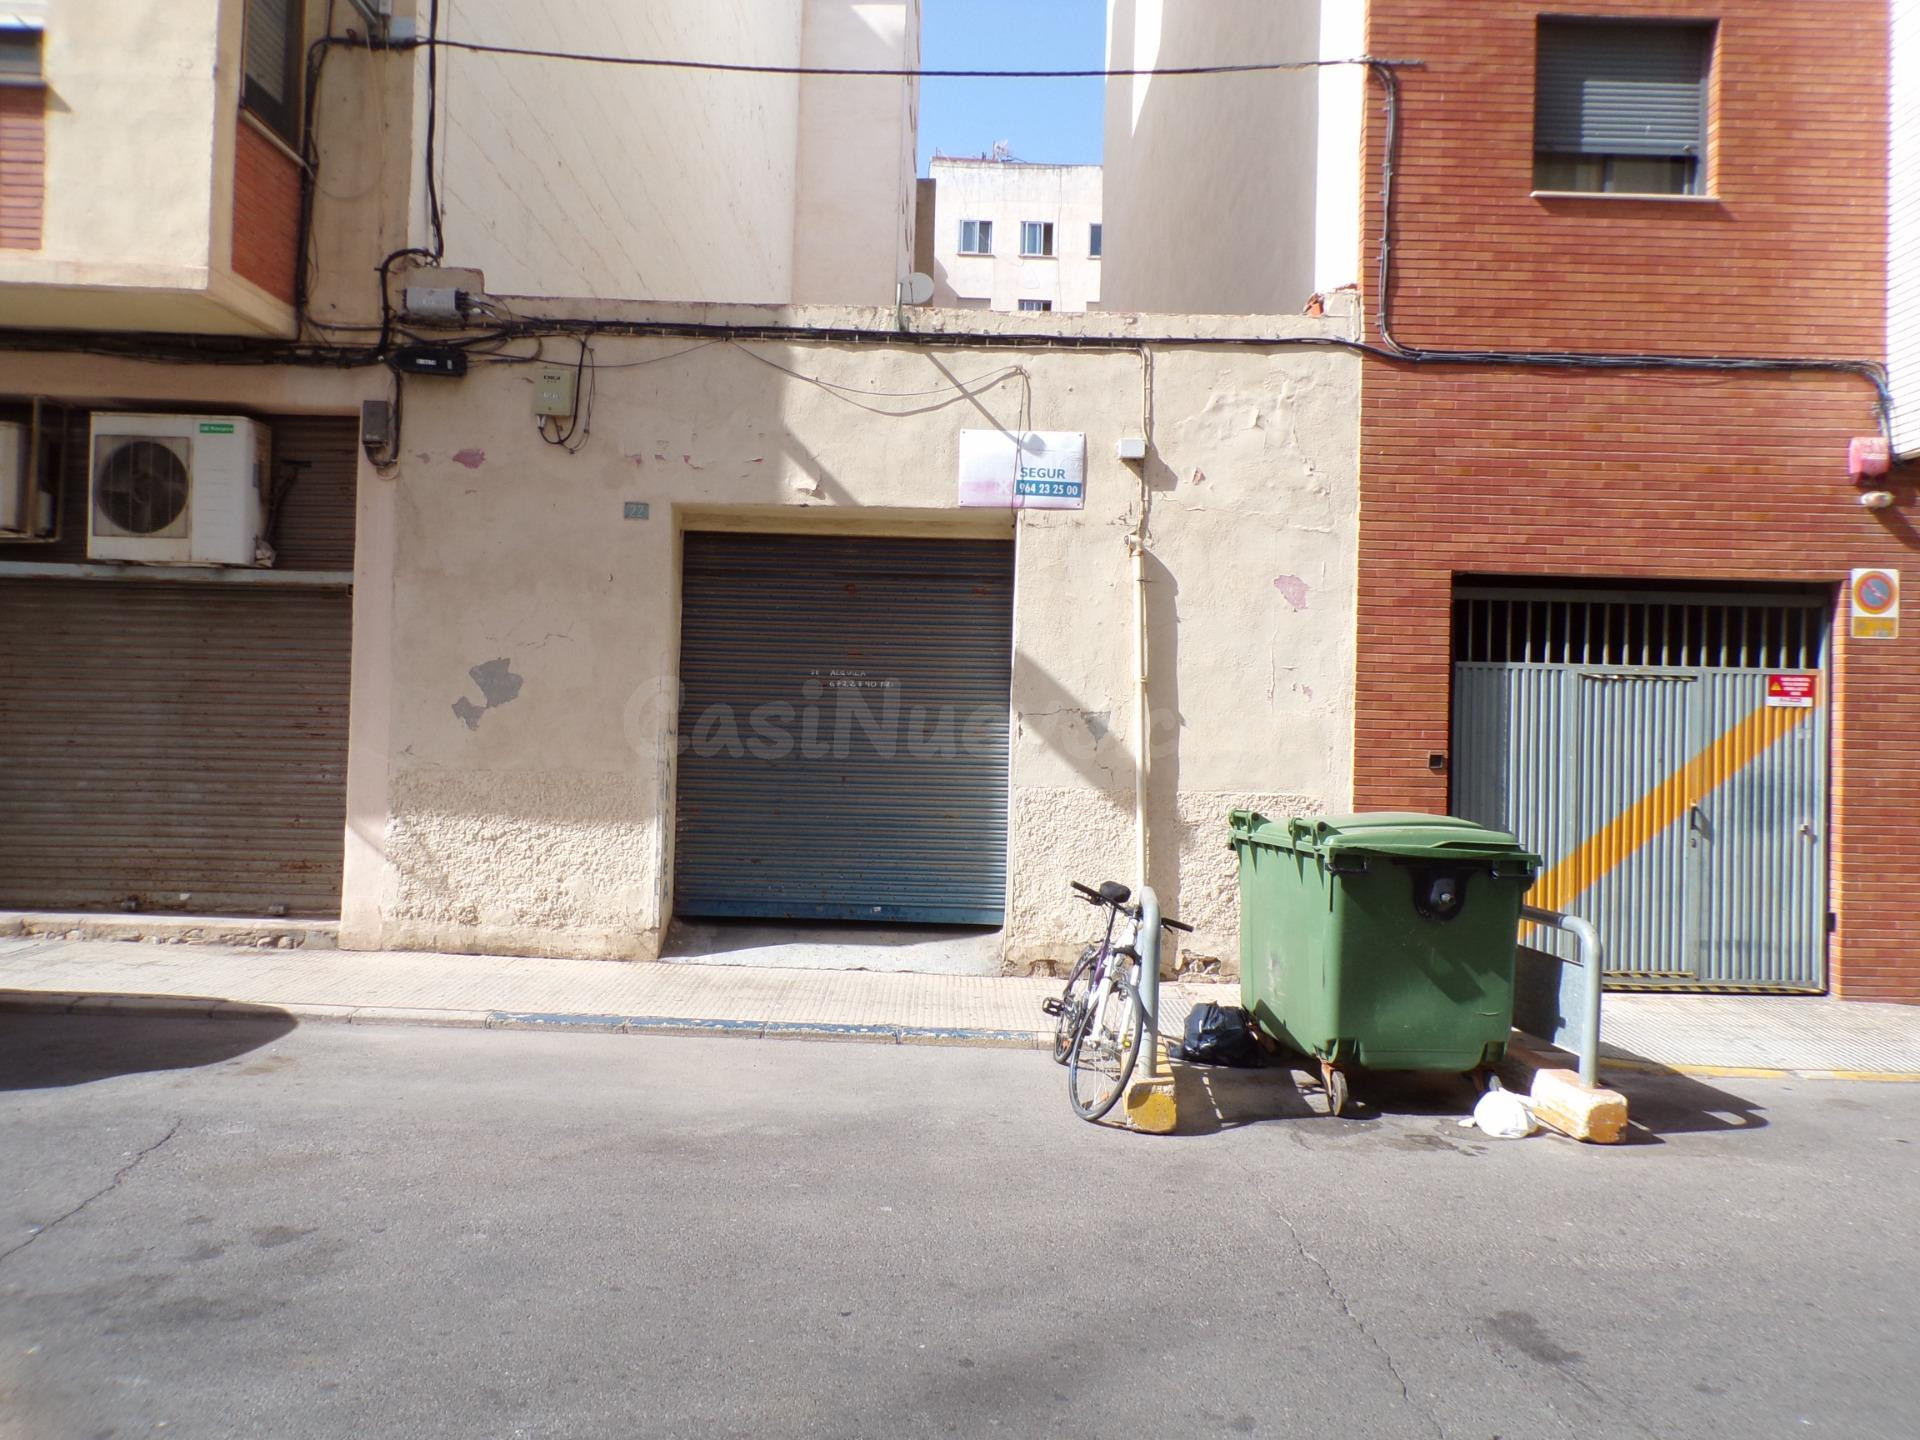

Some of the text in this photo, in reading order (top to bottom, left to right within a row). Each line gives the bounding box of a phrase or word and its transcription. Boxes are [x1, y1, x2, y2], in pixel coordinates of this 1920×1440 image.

[1020, 467, 1066, 479] SEGUR
[1019, 483, 1078, 496] 964 23 25 00
